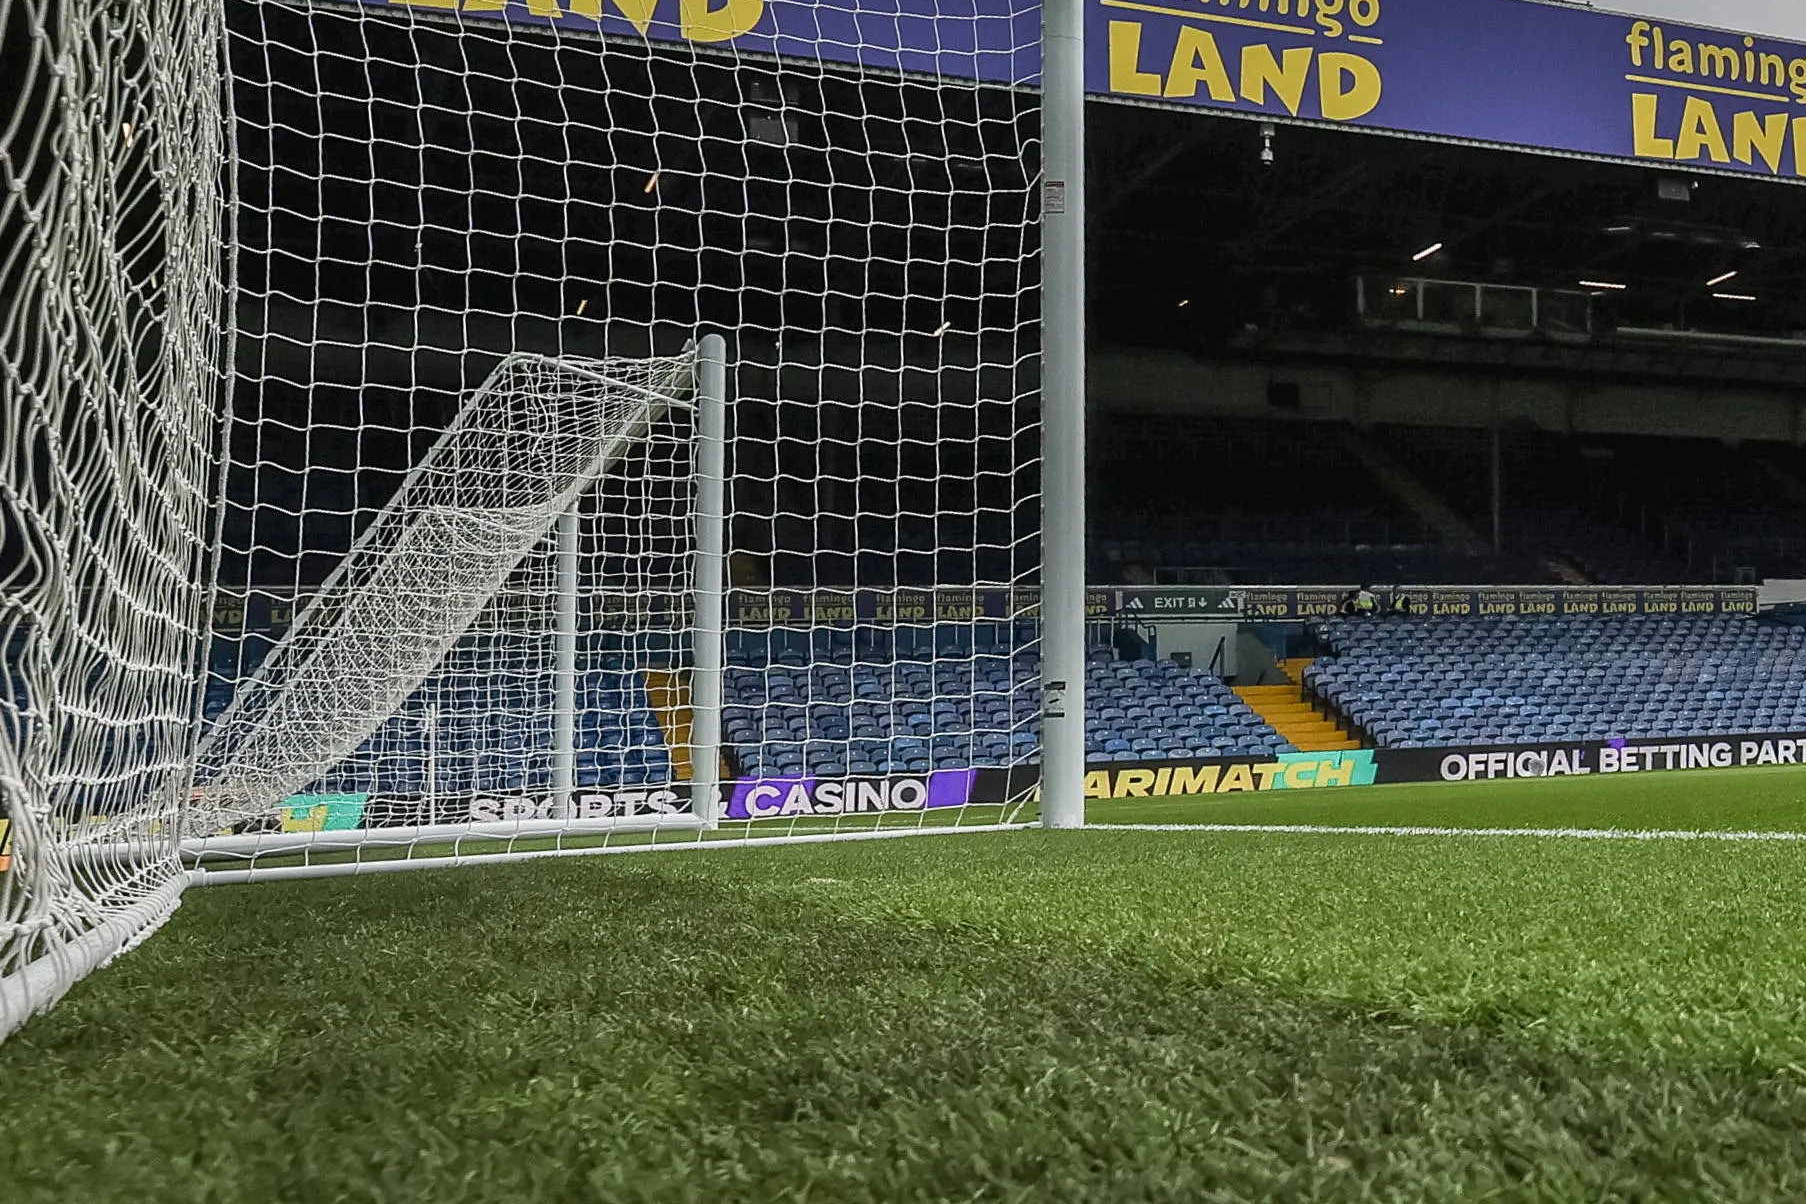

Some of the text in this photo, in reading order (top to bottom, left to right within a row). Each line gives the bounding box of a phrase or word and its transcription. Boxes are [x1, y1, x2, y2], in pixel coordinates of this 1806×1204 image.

[1109, 20, 1382, 121] LAND
[1154, 597, 1185, 609] EXIT
[1297, 603, 1337, 615] LAND
[1433, 603, 1470, 614] LAND
[1479, 603, 1515, 614] LAND
[1520, 603, 1555, 614] LAND
[1564, 602, 1598, 613] LAND
[1603, 602, 1636, 613] LAND
[1644, 602, 1677, 613] LAND
[1682, 602, 1713, 612] LAND
[1722, 602, 1753, 612] LAND
[739, 607, 791, 620] LAND
[937, 606, 985, 618] LAND
[1247, 604, 1287, 616] AND
[1440, 749, 1591, 781] OFFICIAL
[1600, 742, 1733, 773] BETTING
[1084, 759, 1354, 800] ARIMATCH
[745, 779, 927, 816] CASINO
